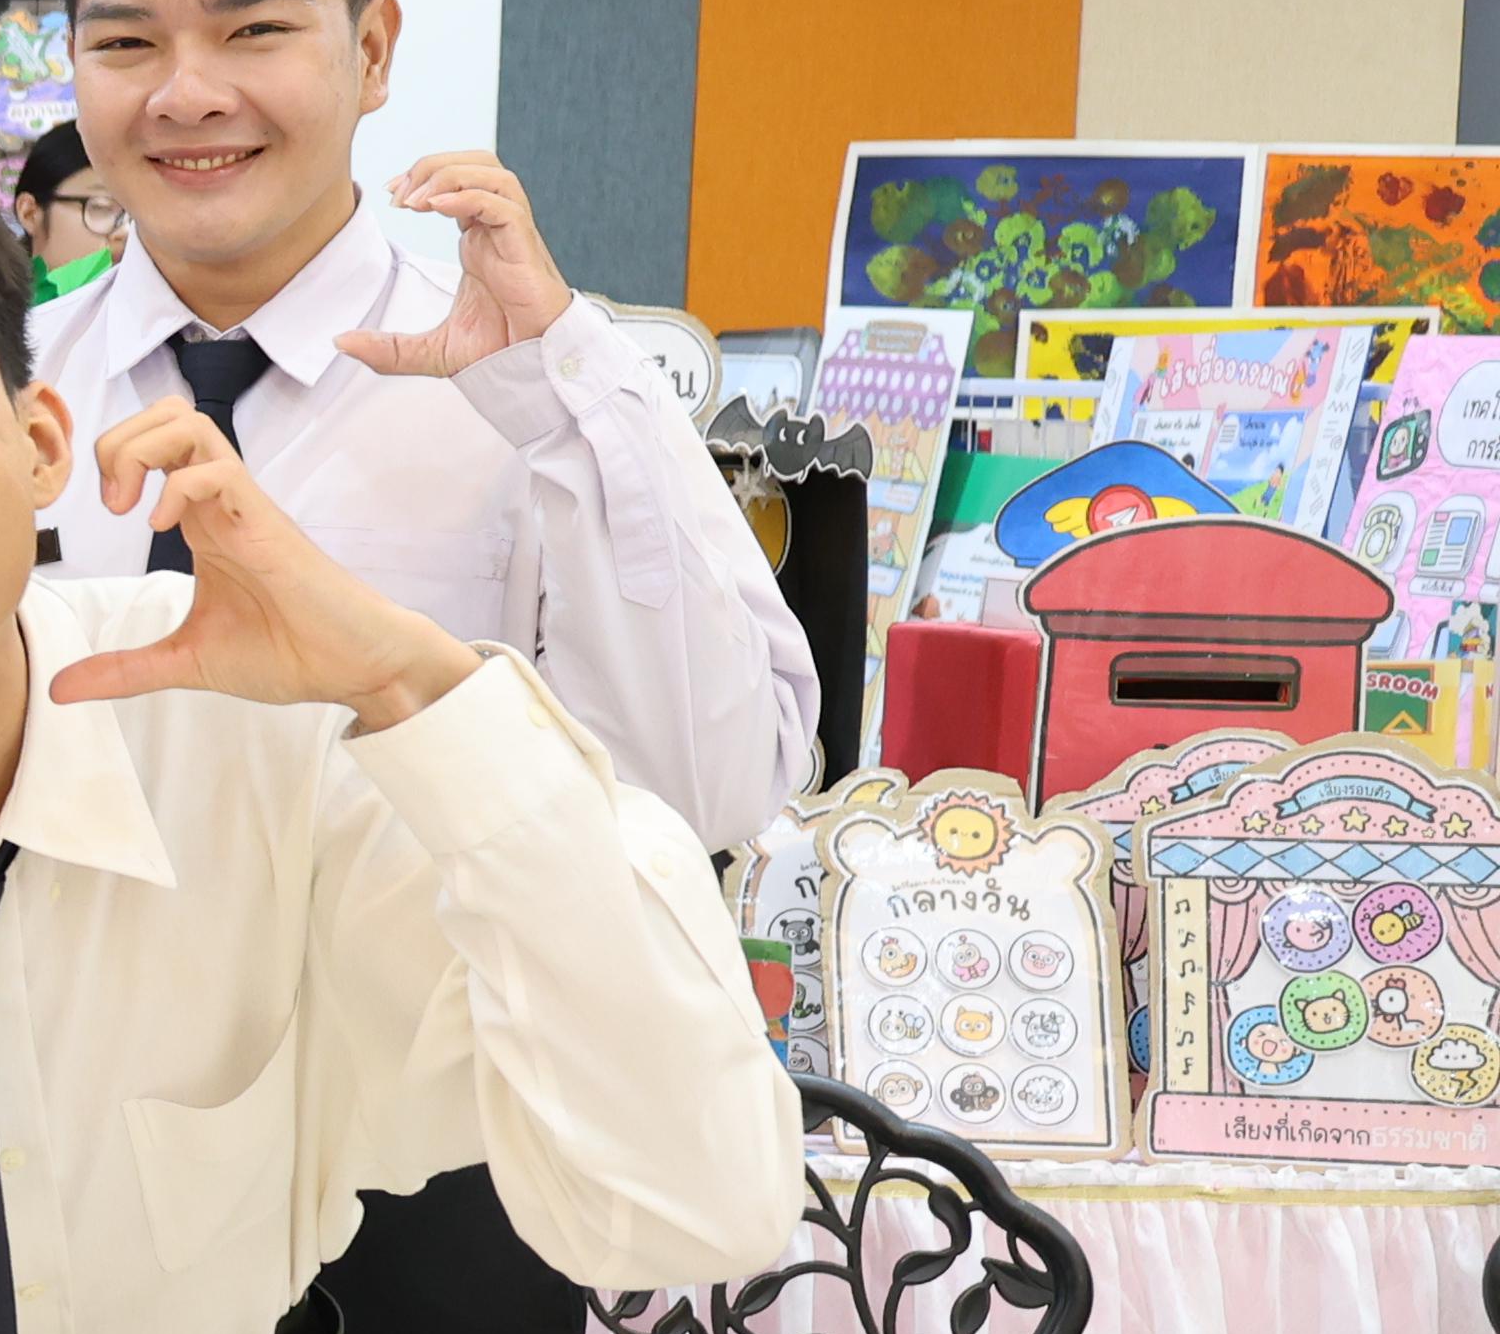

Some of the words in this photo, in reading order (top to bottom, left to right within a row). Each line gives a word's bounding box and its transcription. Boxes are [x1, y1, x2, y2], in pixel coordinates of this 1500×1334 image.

[1462, 389, 1500, 421] เทคโ
[1366, 673, 1439, 700] SROOM
[887, 877, 1031, 921] กลางวัน
